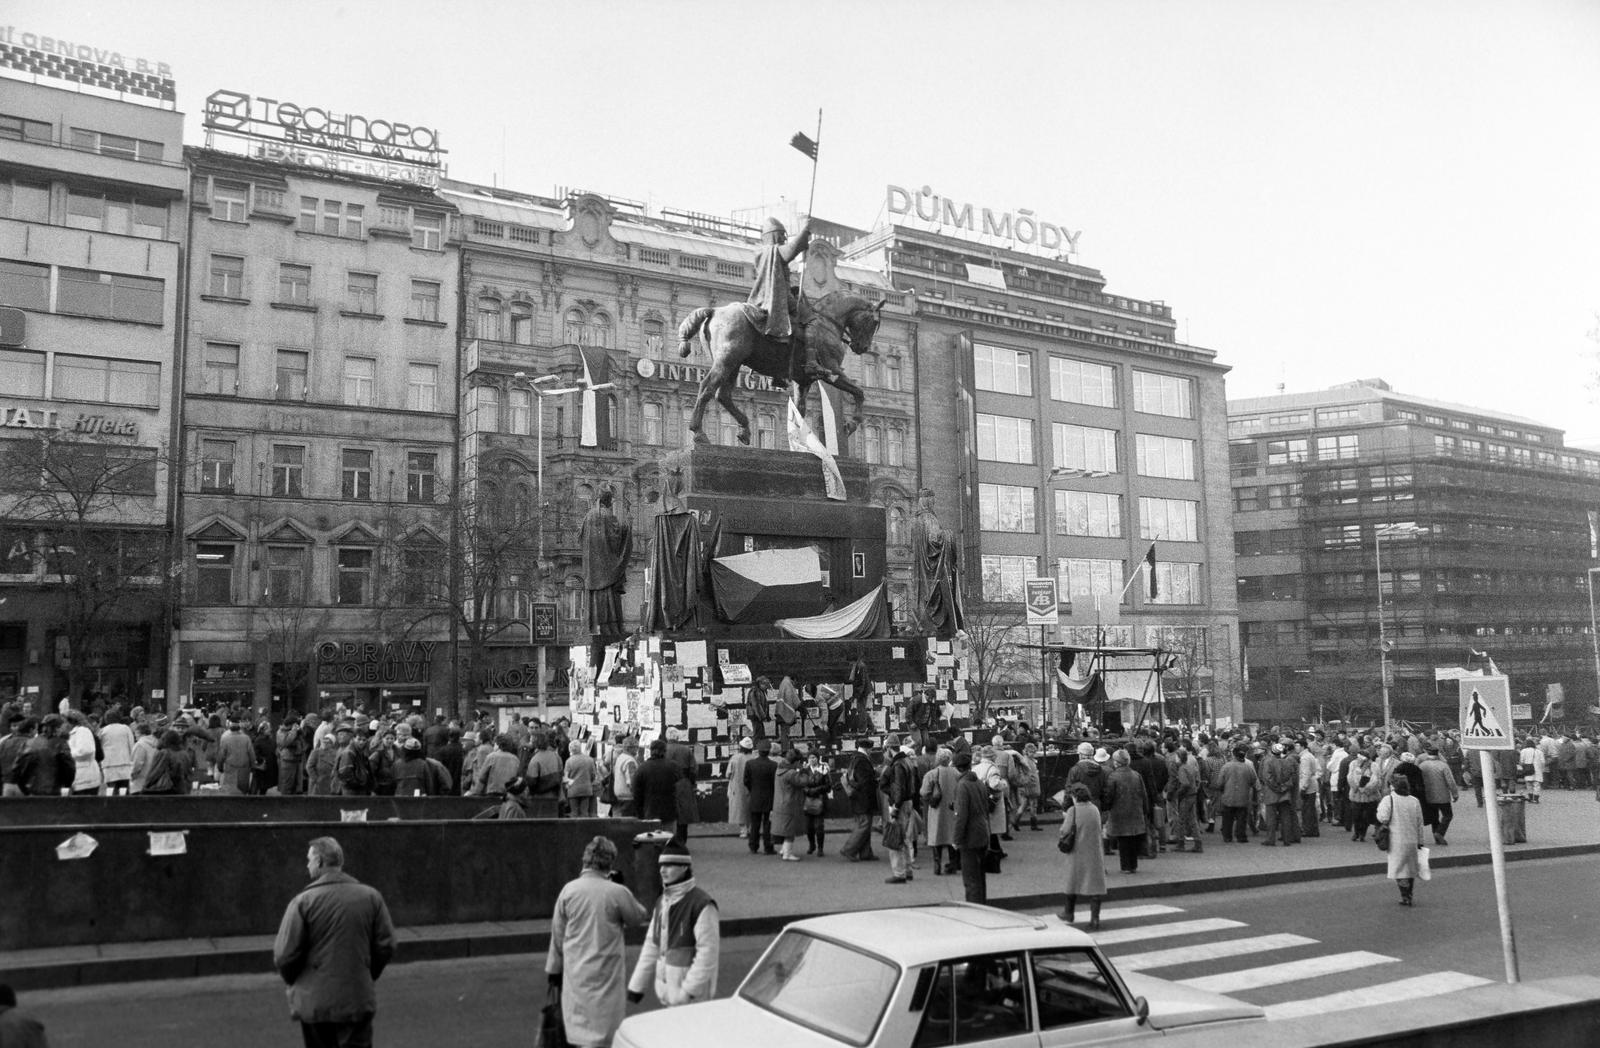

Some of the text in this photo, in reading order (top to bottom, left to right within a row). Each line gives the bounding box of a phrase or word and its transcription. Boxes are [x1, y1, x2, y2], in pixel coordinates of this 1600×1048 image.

[22, 32, 125, 71] OBNOVA
[256, 96, 448, 154] TECHNOPOL
[284, 126, 406, 161] BRATISLAVA
[886, 184, 974, 231] DŮM
[319, 641, 436, 662] OPRAVY
[341, 663, 431, 683] OBUVI
